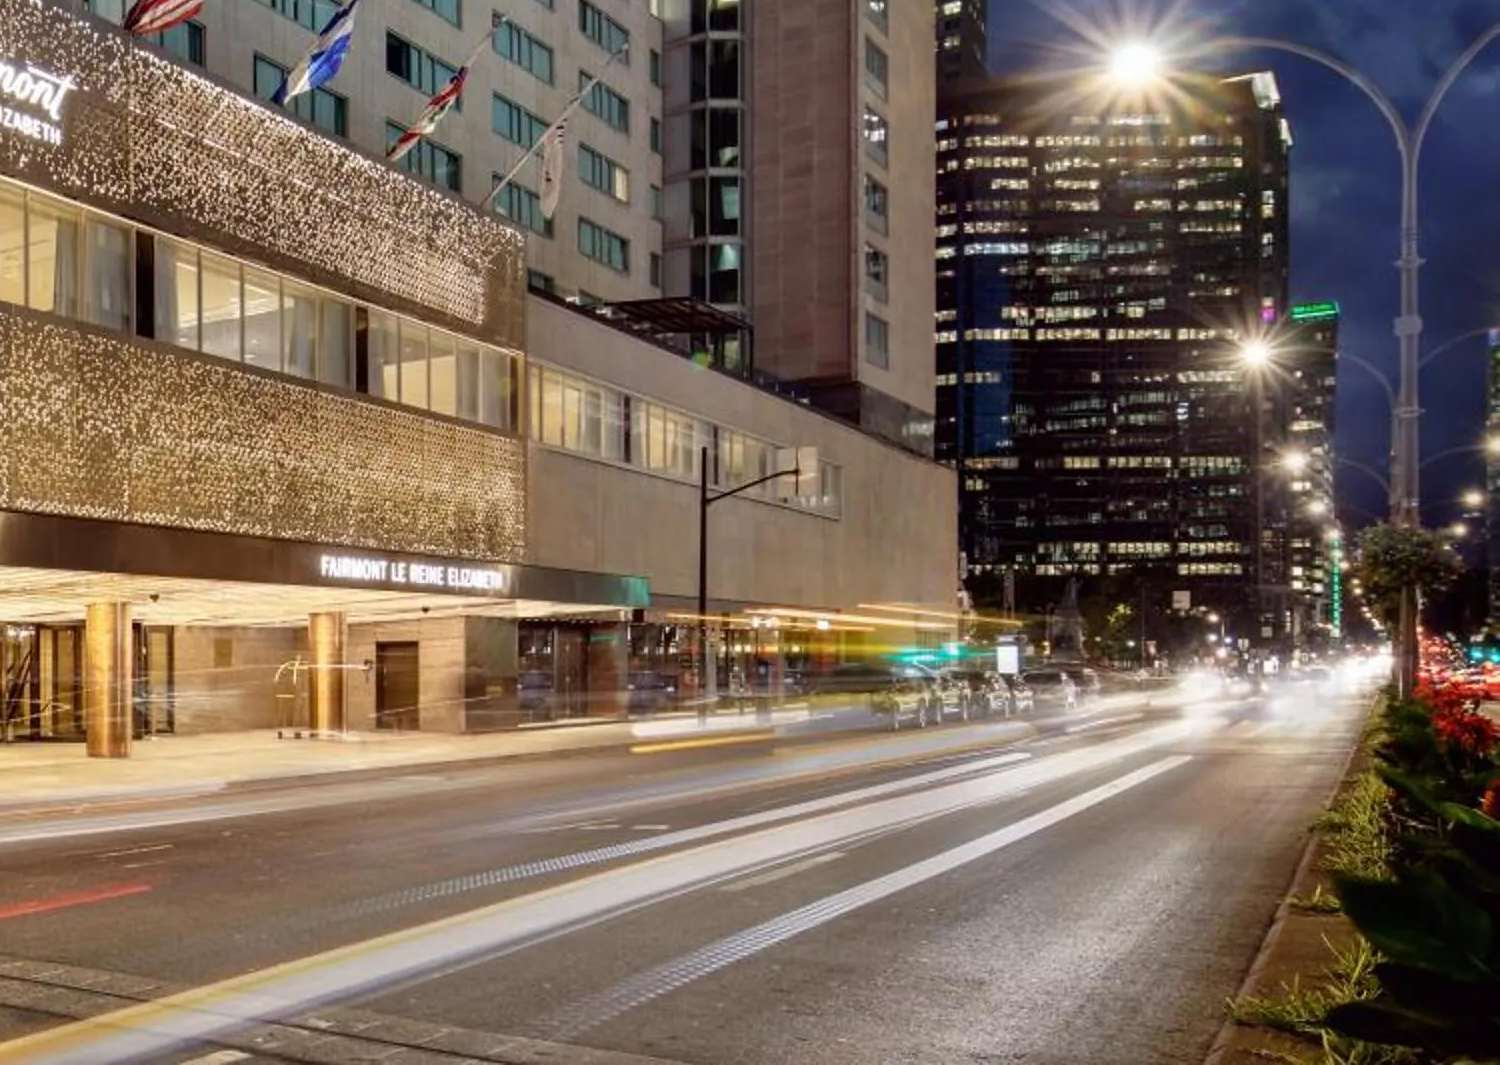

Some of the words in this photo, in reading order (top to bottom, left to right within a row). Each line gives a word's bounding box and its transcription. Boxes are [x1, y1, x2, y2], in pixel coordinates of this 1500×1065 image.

[321, 555, 388, 580] FAIRMONT
[391, 562, 407, 583] LE
[409, 563, 445, 585] REINE
[447, 567, 503, 589] ELIZABETH
